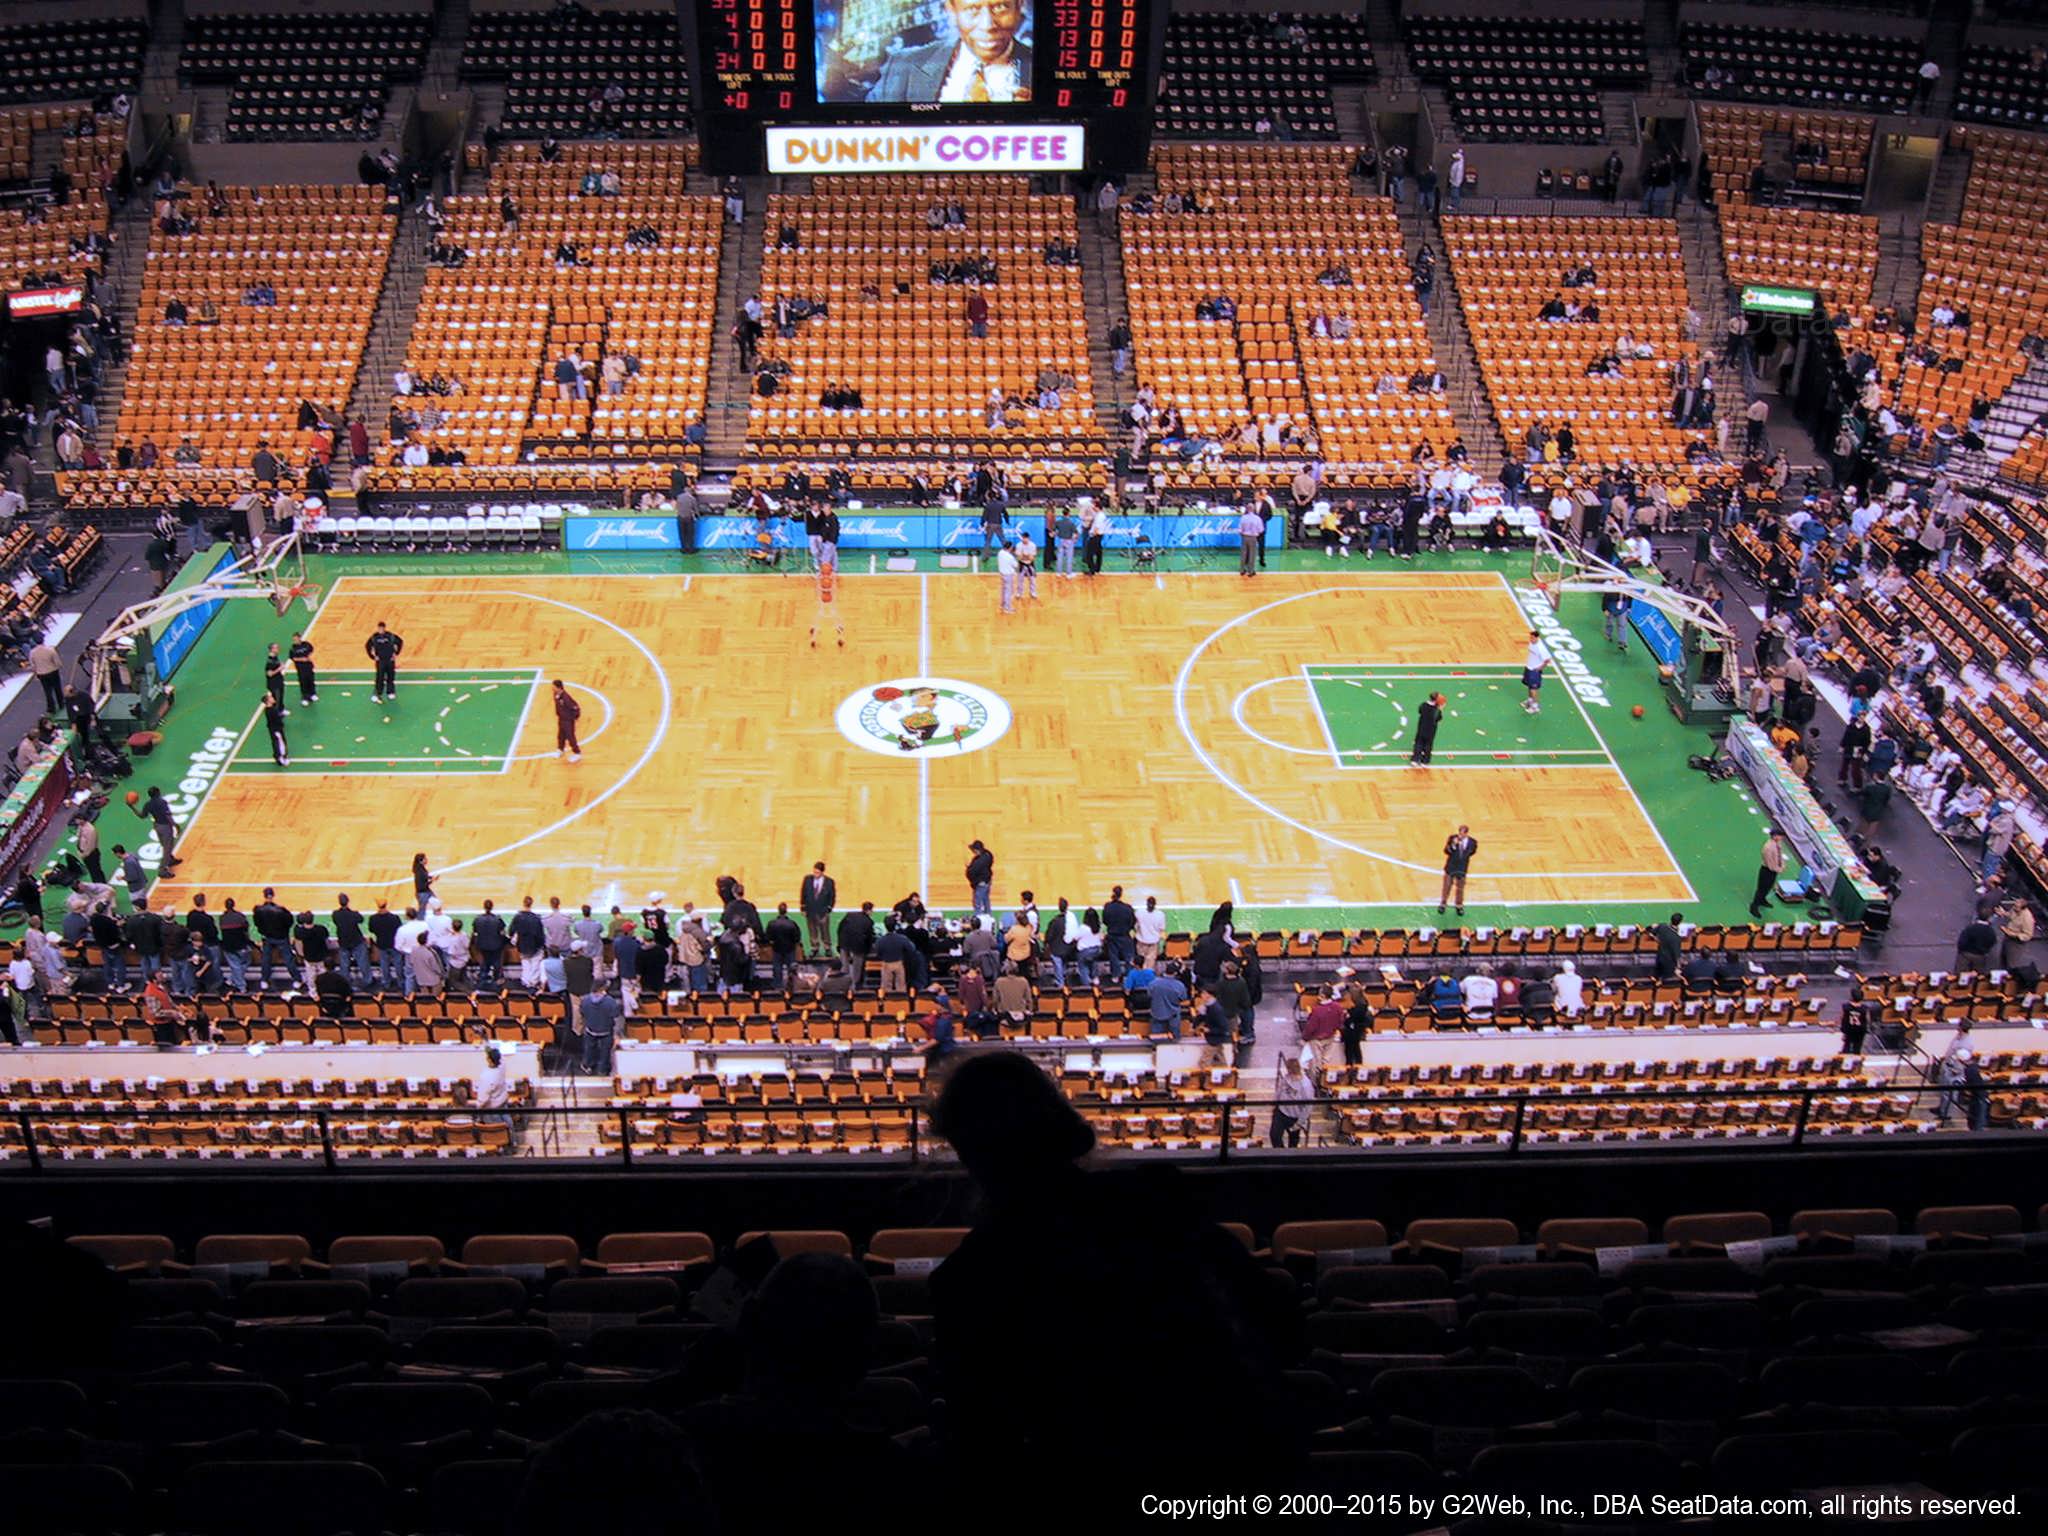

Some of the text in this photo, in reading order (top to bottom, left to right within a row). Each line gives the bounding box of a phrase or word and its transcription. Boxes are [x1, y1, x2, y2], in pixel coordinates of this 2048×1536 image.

[725, 11, 795, 29] 4 0 0
[1054, 9, 1135, 28] 33 0 0
[727, 31, 795, 50] 7 0 0
[1059, 29, 1135, 48] 13 0 0
[715, 52, 796, 70] 34 0 0
[1058, 49, 1133, 68] 15 0 0
[779, 91, 791, 109] 0
[1058, 89, 1071, 107] 0
[1113, 89, 1126, 107] 0
[910, 103, 942, 112] SONY
[785, 135, 1067, 165] DUNKIN' COFFEE
[1513, 587, 1611, 707] FleetCenter
